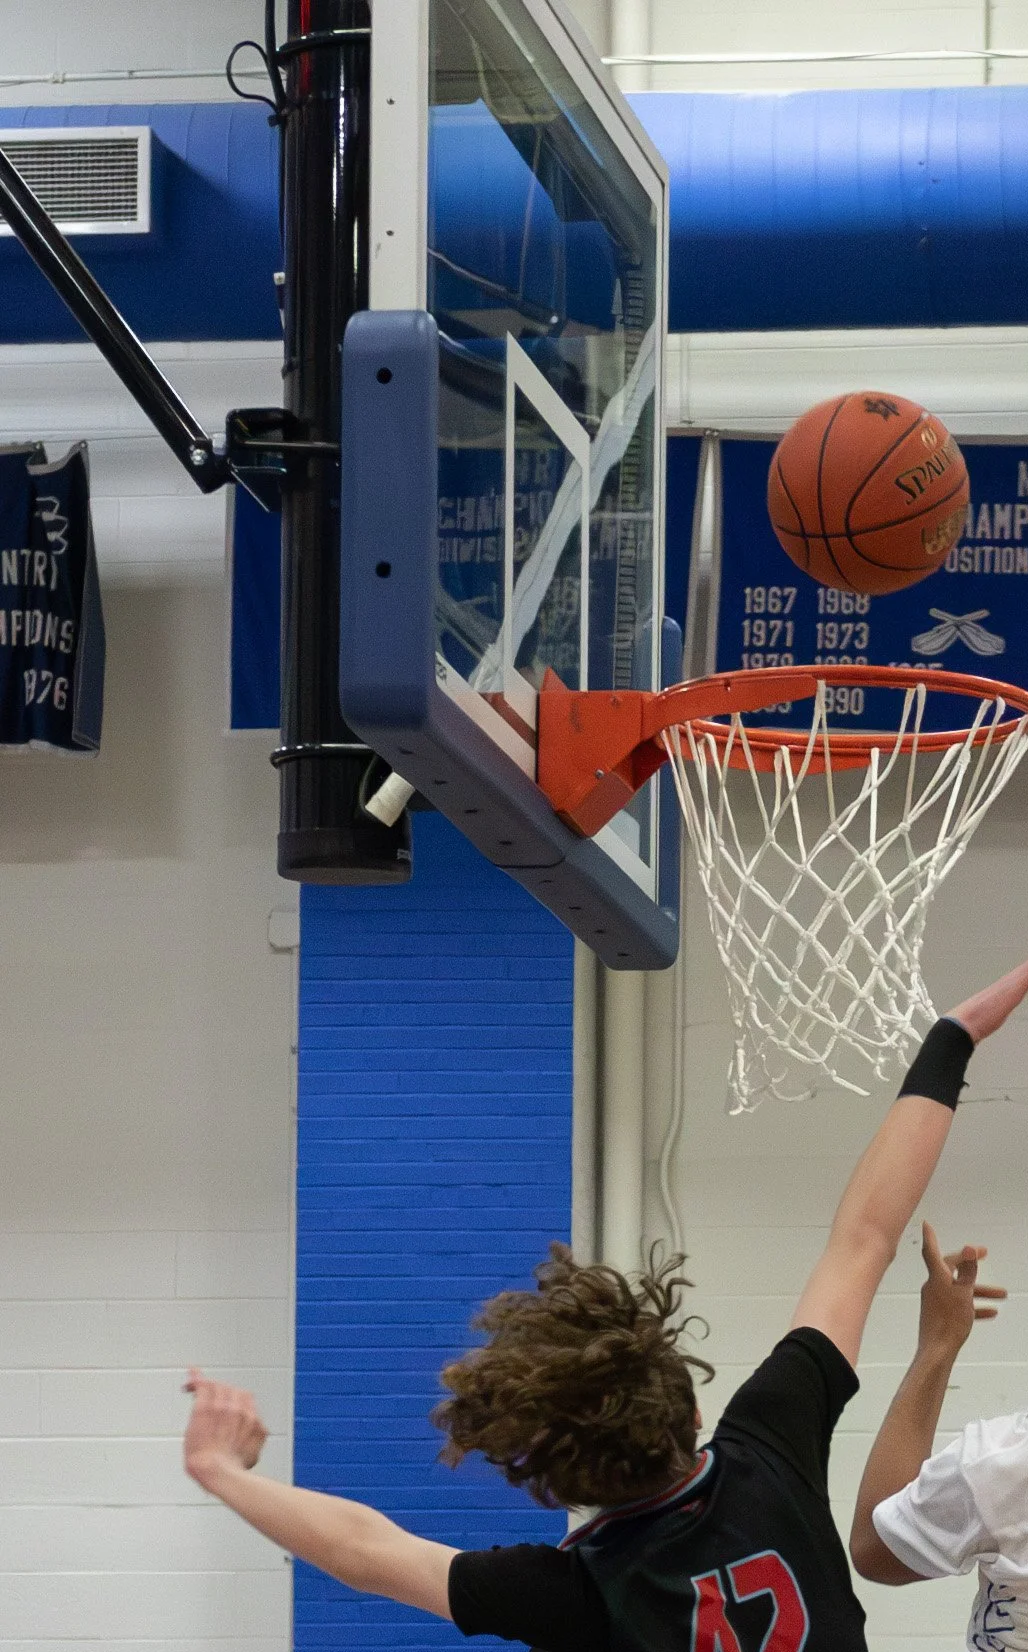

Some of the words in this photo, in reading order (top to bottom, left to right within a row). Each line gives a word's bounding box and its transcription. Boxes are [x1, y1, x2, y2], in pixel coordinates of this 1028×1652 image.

[744, 586, 797, 614] 1967
[817, 587, 871, 614] 1968
[742, 619, 795, 647] 1971
[816, 622, 869, 650] 1973
[824, 687, 865, 715] 990
